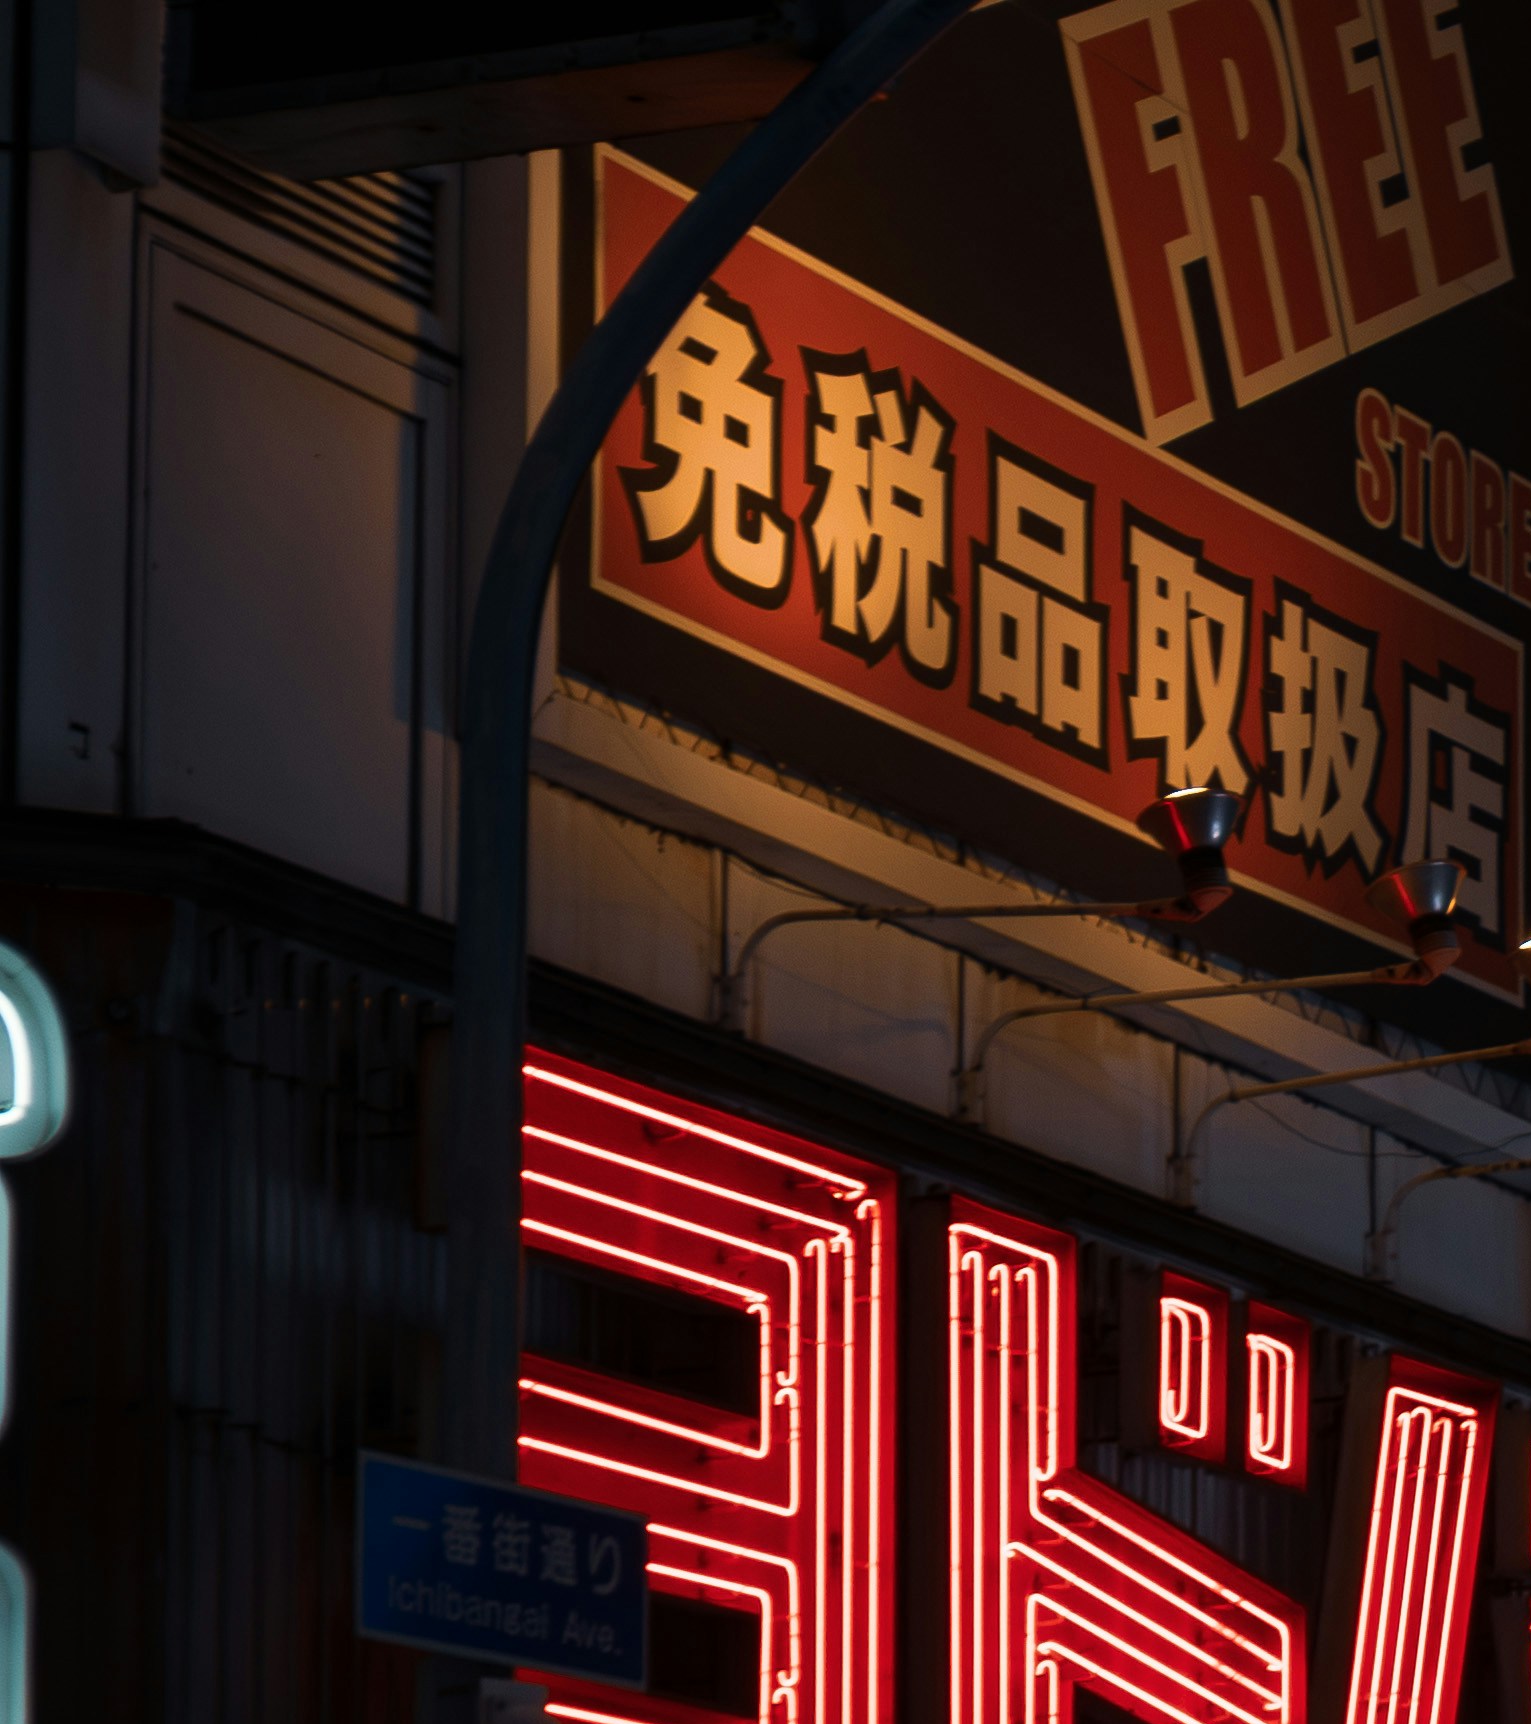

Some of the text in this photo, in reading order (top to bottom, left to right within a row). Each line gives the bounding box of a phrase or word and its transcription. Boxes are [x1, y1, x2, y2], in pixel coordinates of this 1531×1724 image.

[1058, 0, 1514, 448] FREE
[630, 285, 1512, 955] 免税品取扱店
[386, 1572, 625, 1657] Ichibangai Ave.
[390, 1501, 623, 1597] 一番街通り
